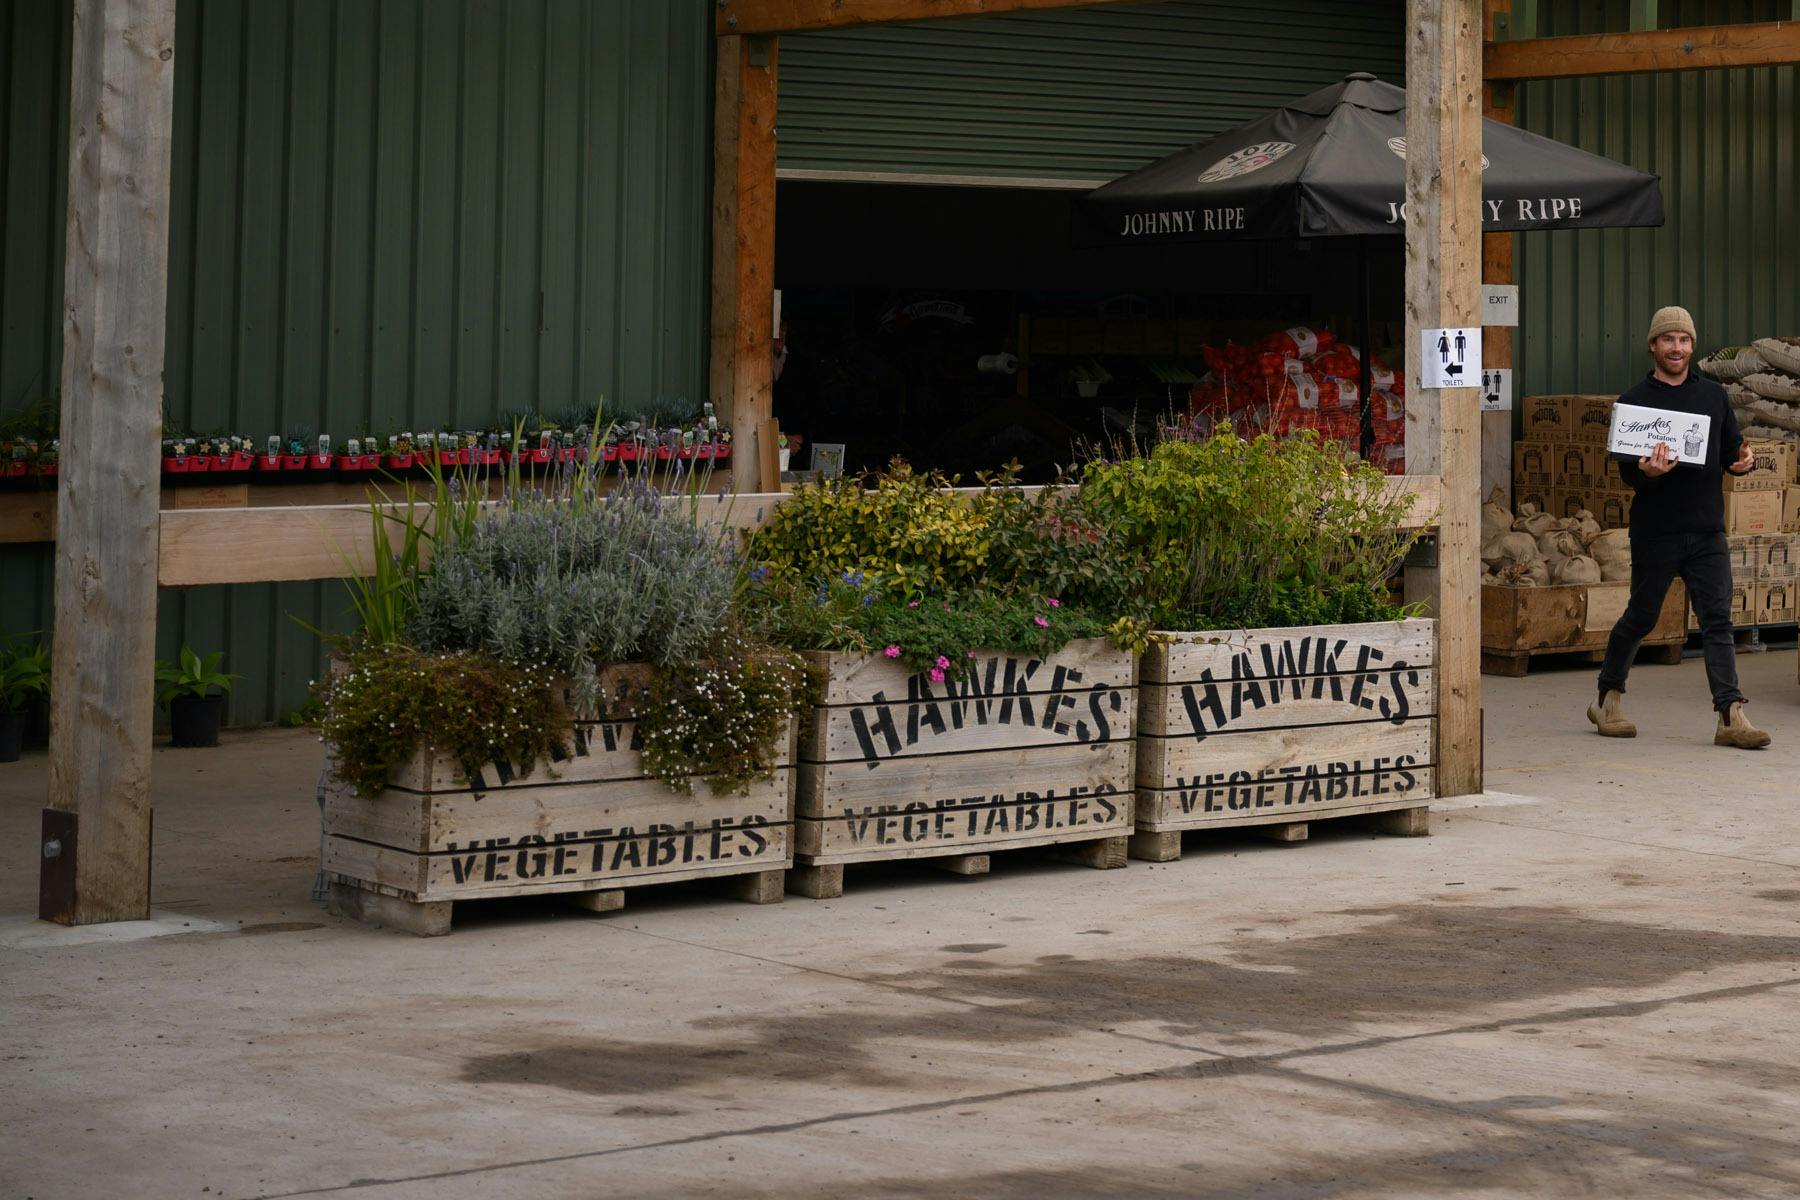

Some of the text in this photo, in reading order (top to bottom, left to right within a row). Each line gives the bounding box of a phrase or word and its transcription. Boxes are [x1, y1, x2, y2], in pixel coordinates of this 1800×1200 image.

[1121, 207, 1245, 236] JOHNNY RIPE
[1518, 198, 1582, 221] RIPE
[1489, 296, 1508, 304] EXIT
[1442, 379, 1464, 387] TOILETS
[1647, 432, 1677, 443] Potatoes
[1181, 636, 1419, 744] HAWKES
[850, 656, 1122, 771] HAWKES
[1176, 754, 1416, 814] VEGETABLES
[844, 783, 1119, 845] VEGETABLES
[447, 814, 768, 885] VEGETABLES
